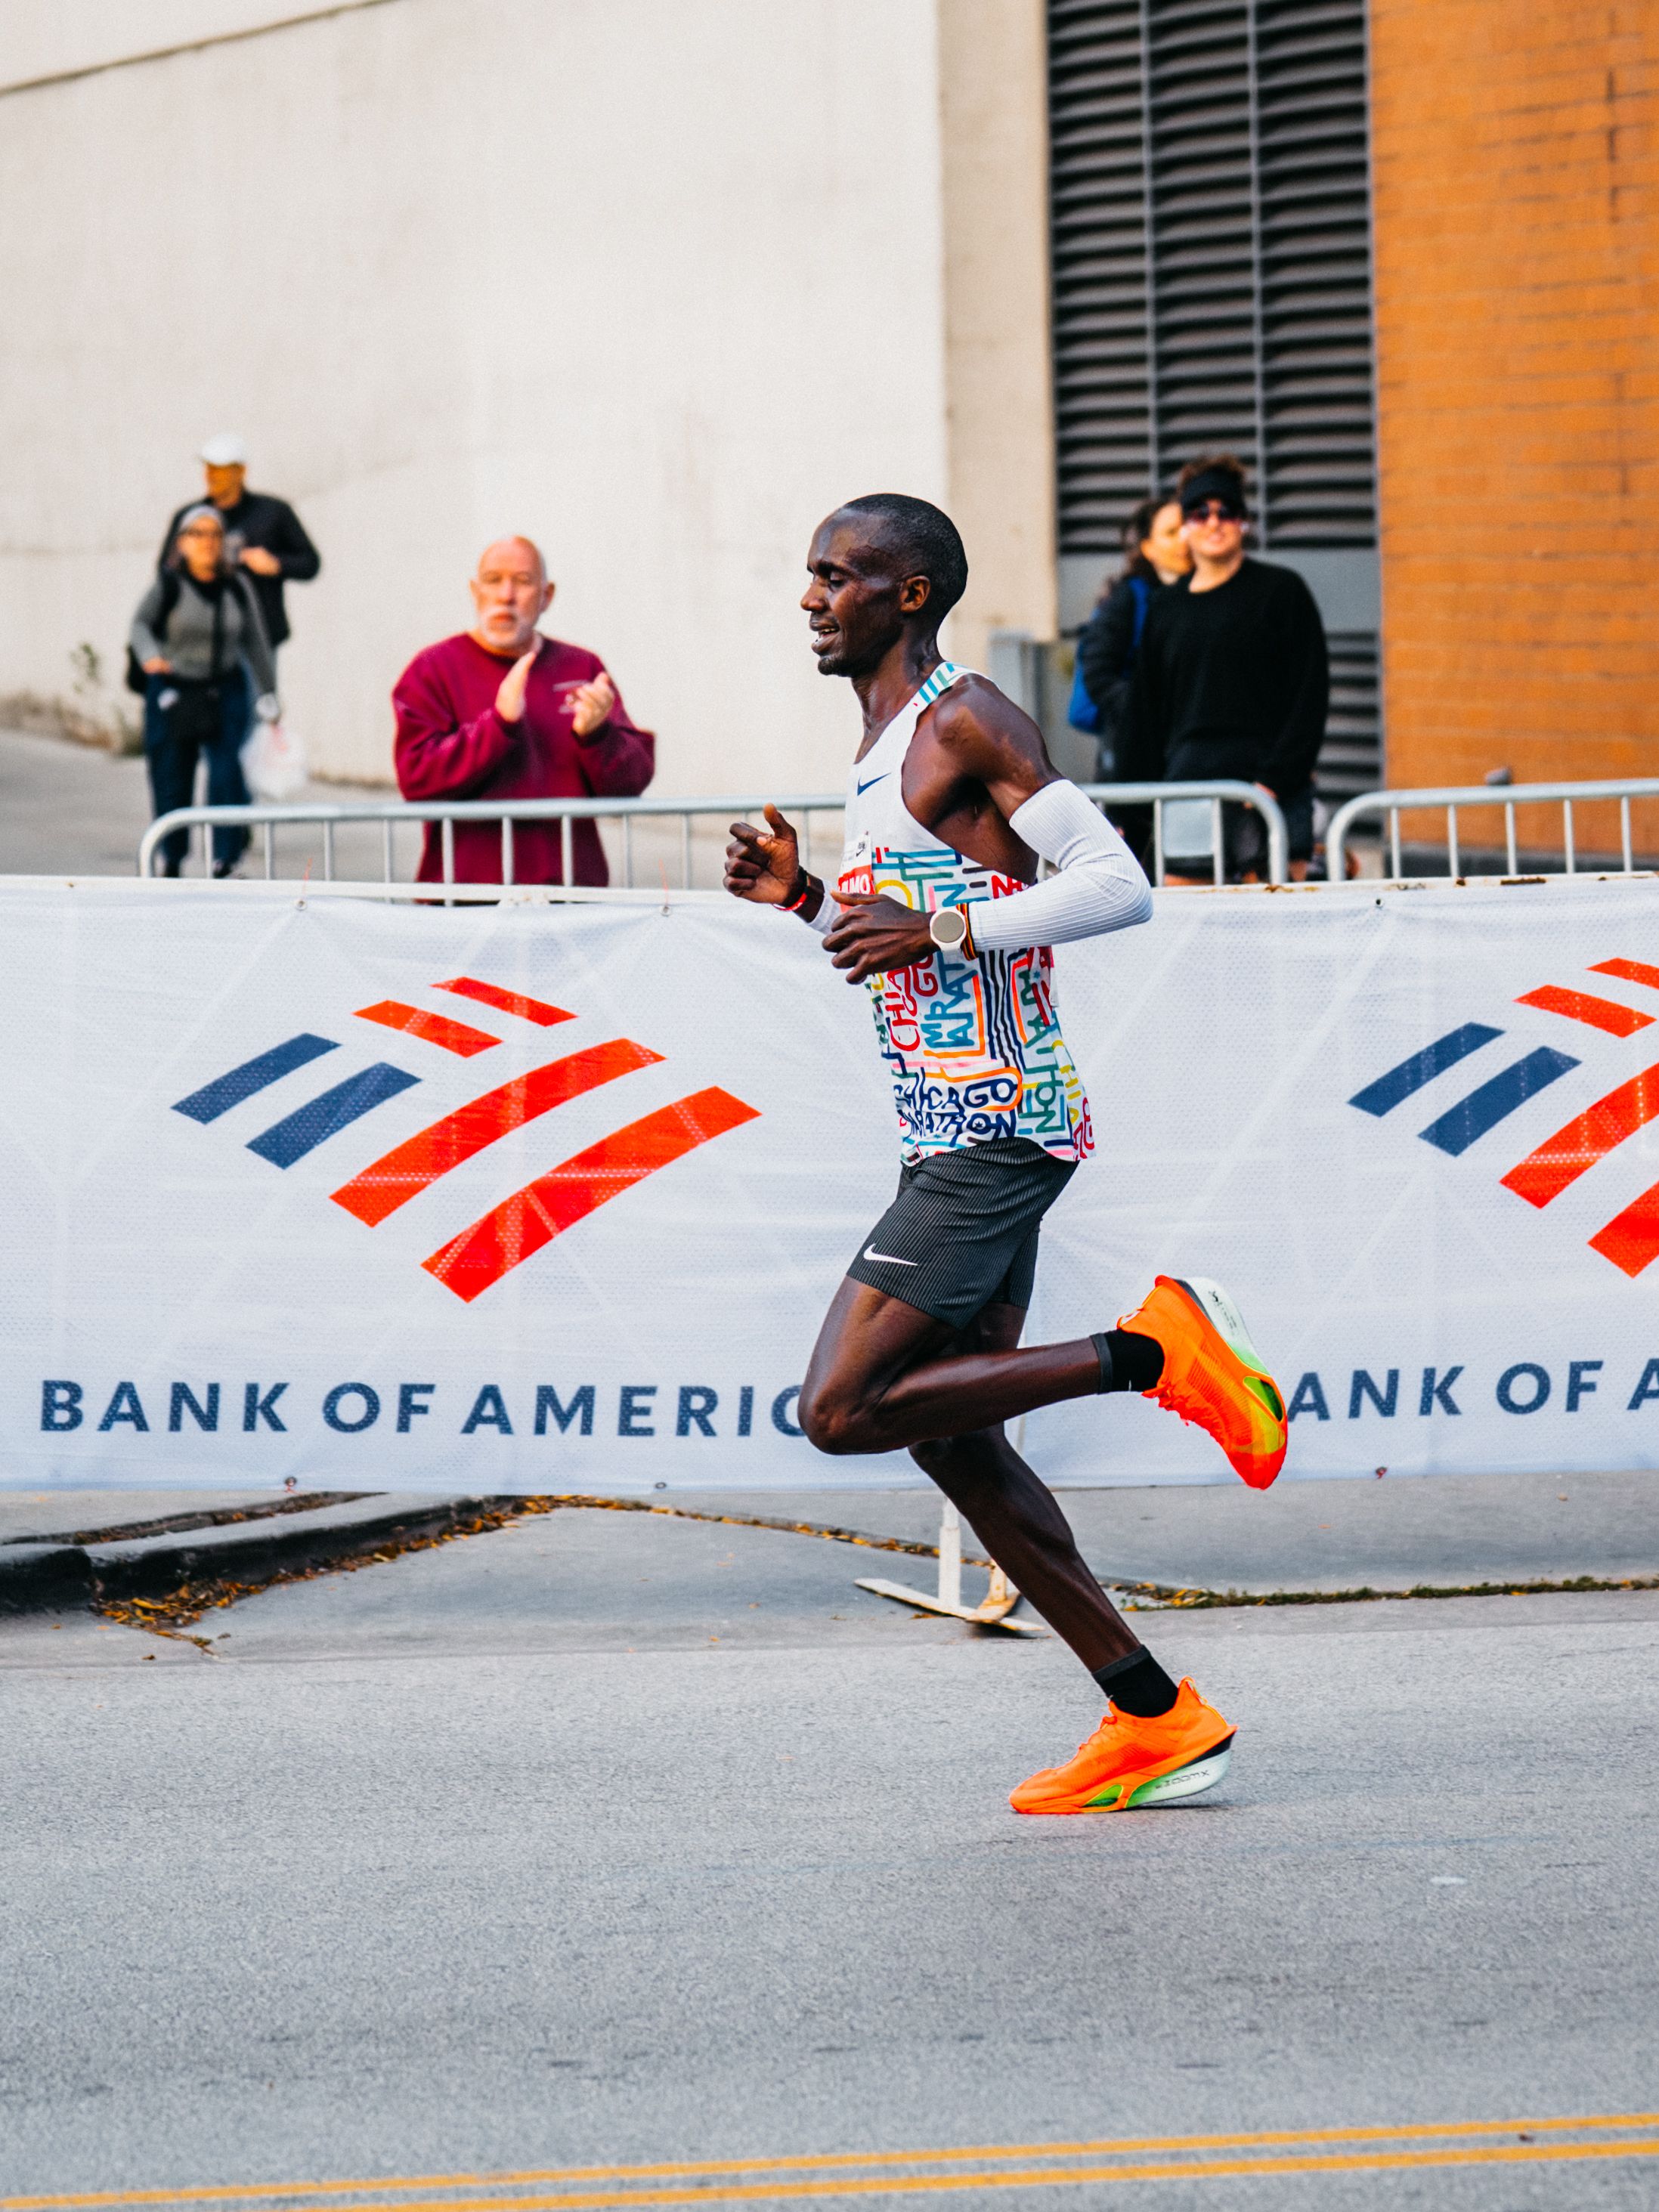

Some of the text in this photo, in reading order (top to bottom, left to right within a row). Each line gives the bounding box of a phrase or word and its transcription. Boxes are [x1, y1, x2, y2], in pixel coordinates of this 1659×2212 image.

[894, 1068, 1015, 1112] CHICAGO
[40, 1380, 806, 1437] BANK OF AMERIC
[1288, 1366, 1465, 1422] ANK
[1496, 1361, 1604, 1415] OF
